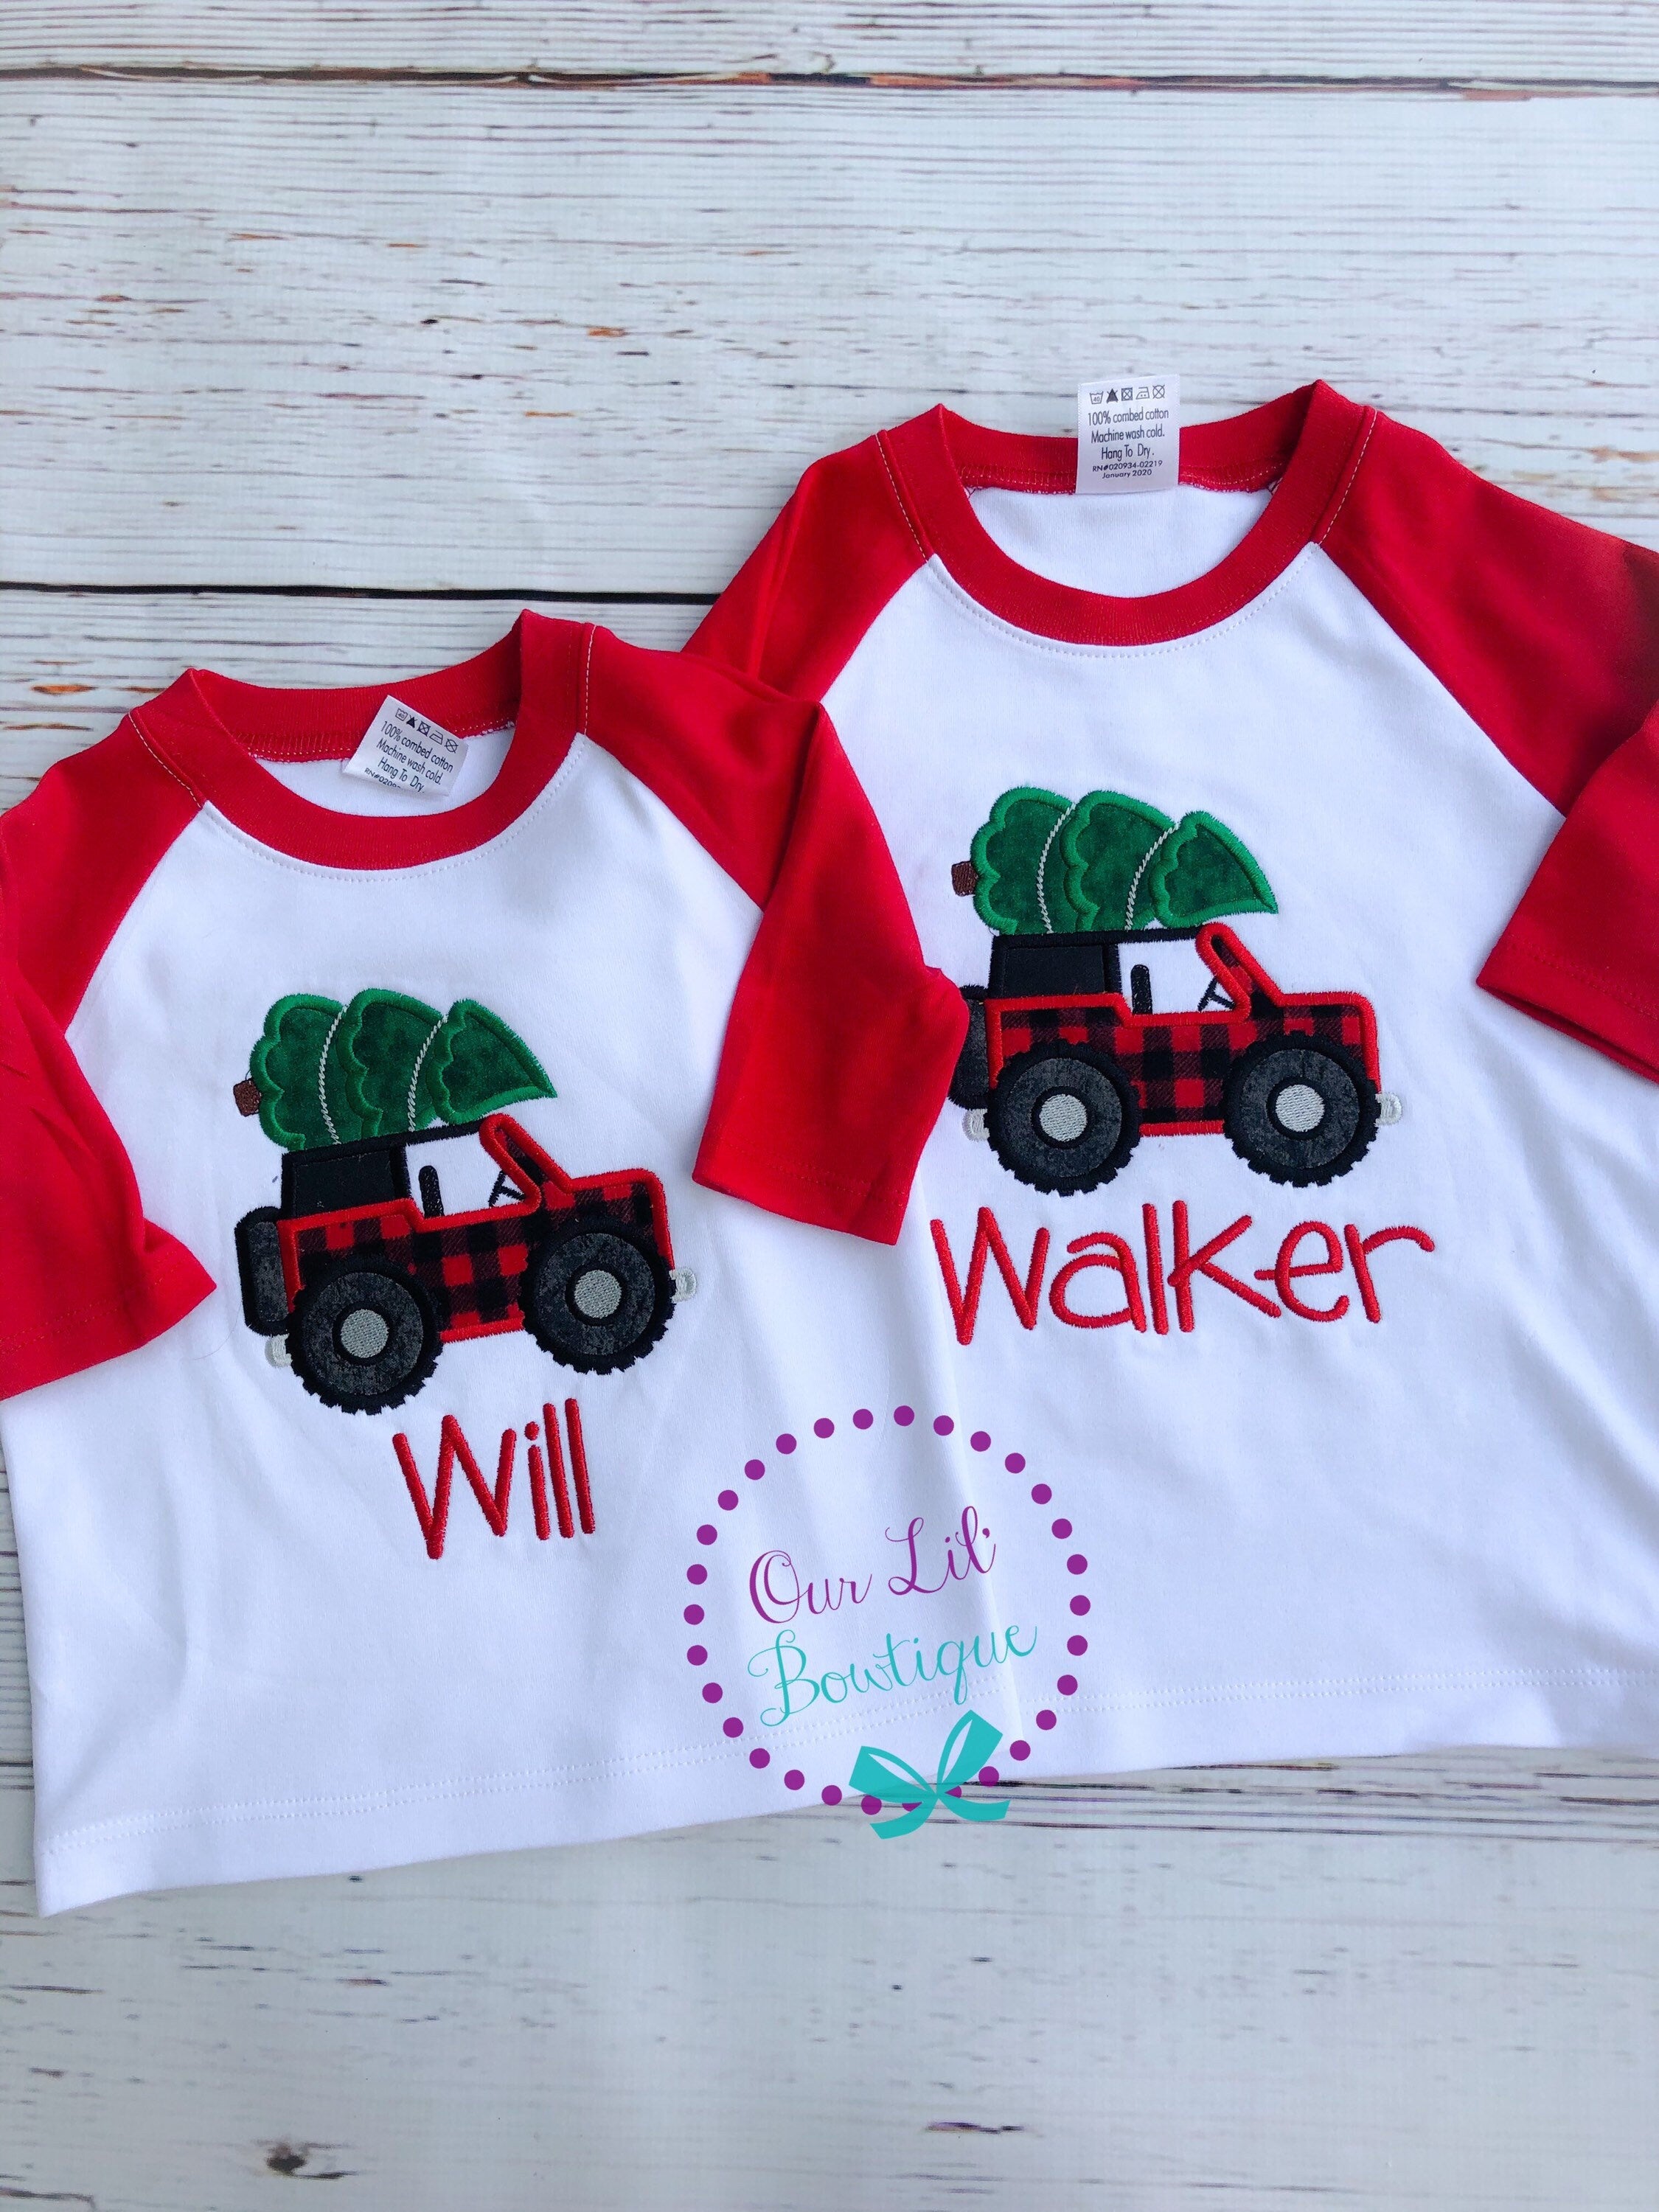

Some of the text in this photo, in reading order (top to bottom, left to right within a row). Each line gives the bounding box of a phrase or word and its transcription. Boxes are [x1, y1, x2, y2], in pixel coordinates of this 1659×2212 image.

[1088, 407, 1169, 425] 100% combed cotton
[1091, 424, 1165, 443] Machine wash cold.
[1102, 448, 1122, 462] Hang
[1124, 445, 1133, 457] To
[377, 738, 443, 785] Machine wash cold.
[380, 721, 453, 773] 100% combed cotton
[364, 768, 401, 788] RN#0209
[378, 757, 425, 793] Hang To Dry.
[931, 1200, 1434, 1345] Walker
[394, 1399, 594, 1558] Will
